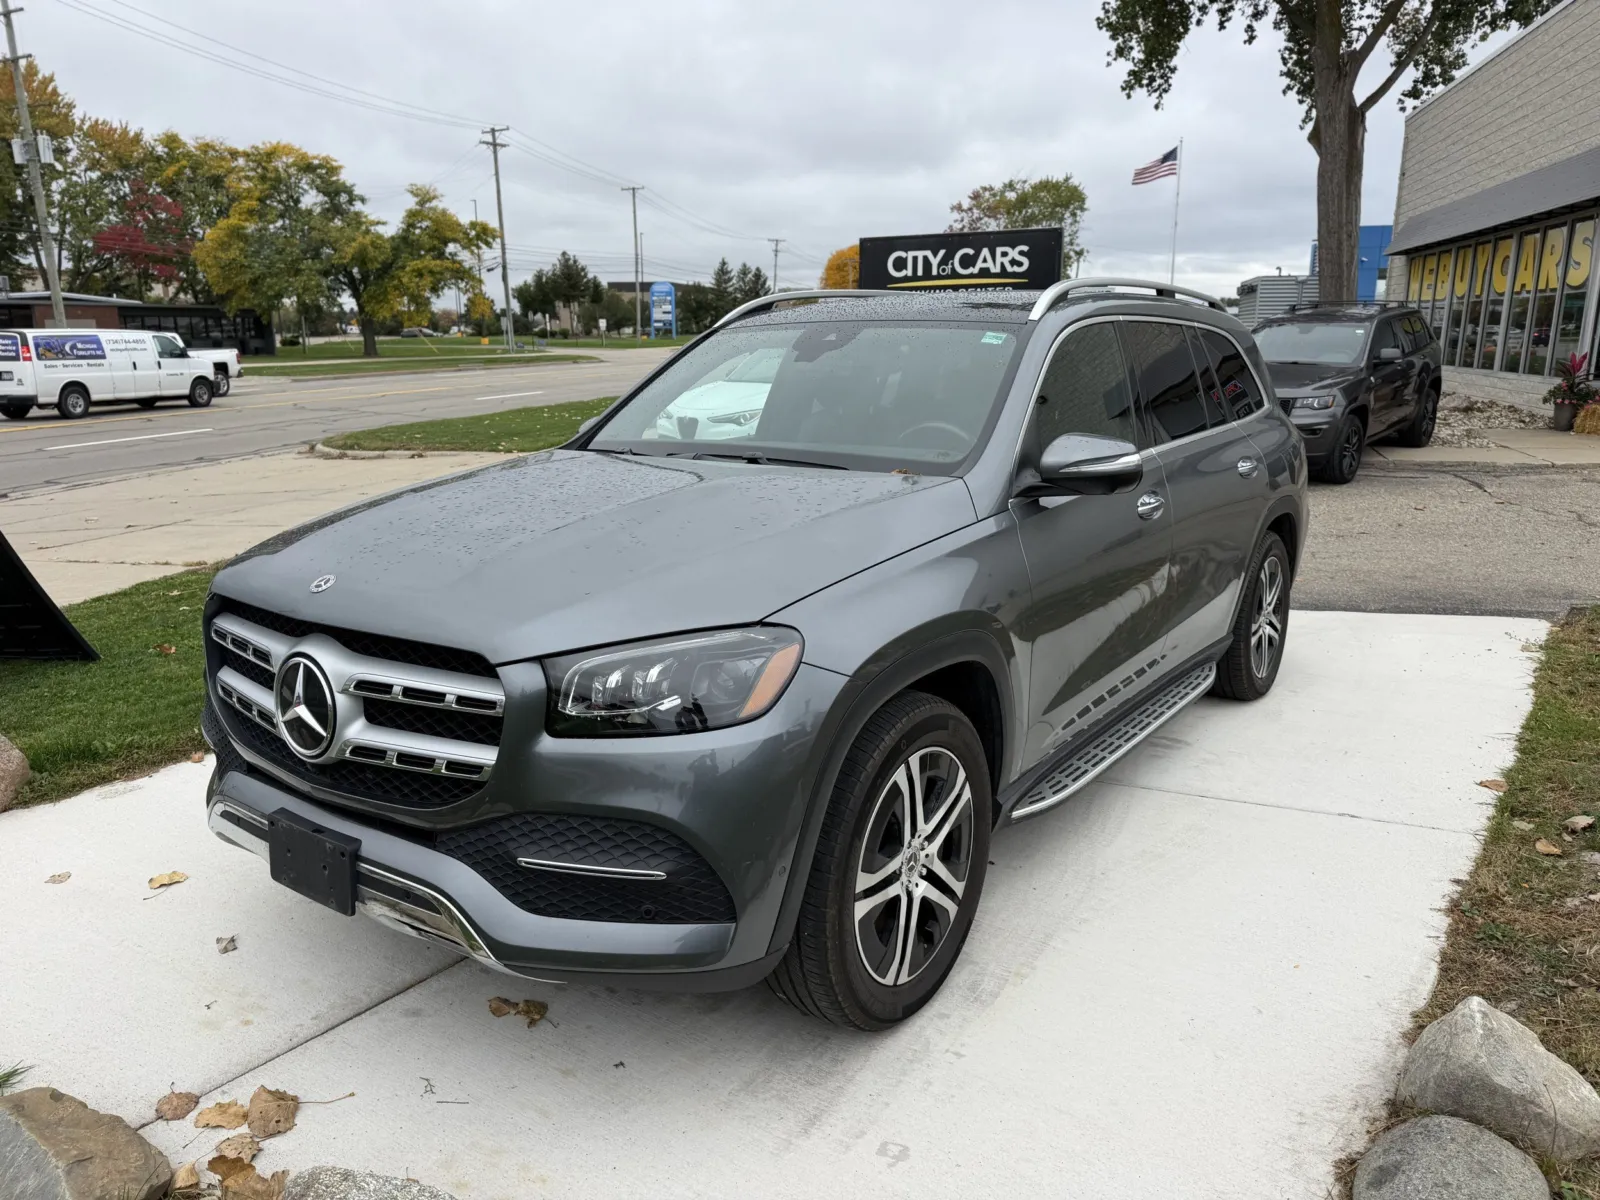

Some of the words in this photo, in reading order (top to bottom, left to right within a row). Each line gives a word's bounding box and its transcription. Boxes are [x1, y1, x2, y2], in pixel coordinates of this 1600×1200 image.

[887, 249, 946, 278] CITY
[939, 260, 953, 276] of
[953, 245, 1030, 275] CARS
[1408, 253, 1436, 301] WE
[1434, 242, 1491, 299] BUY
[1493, 219, 1596, 295] CARS
